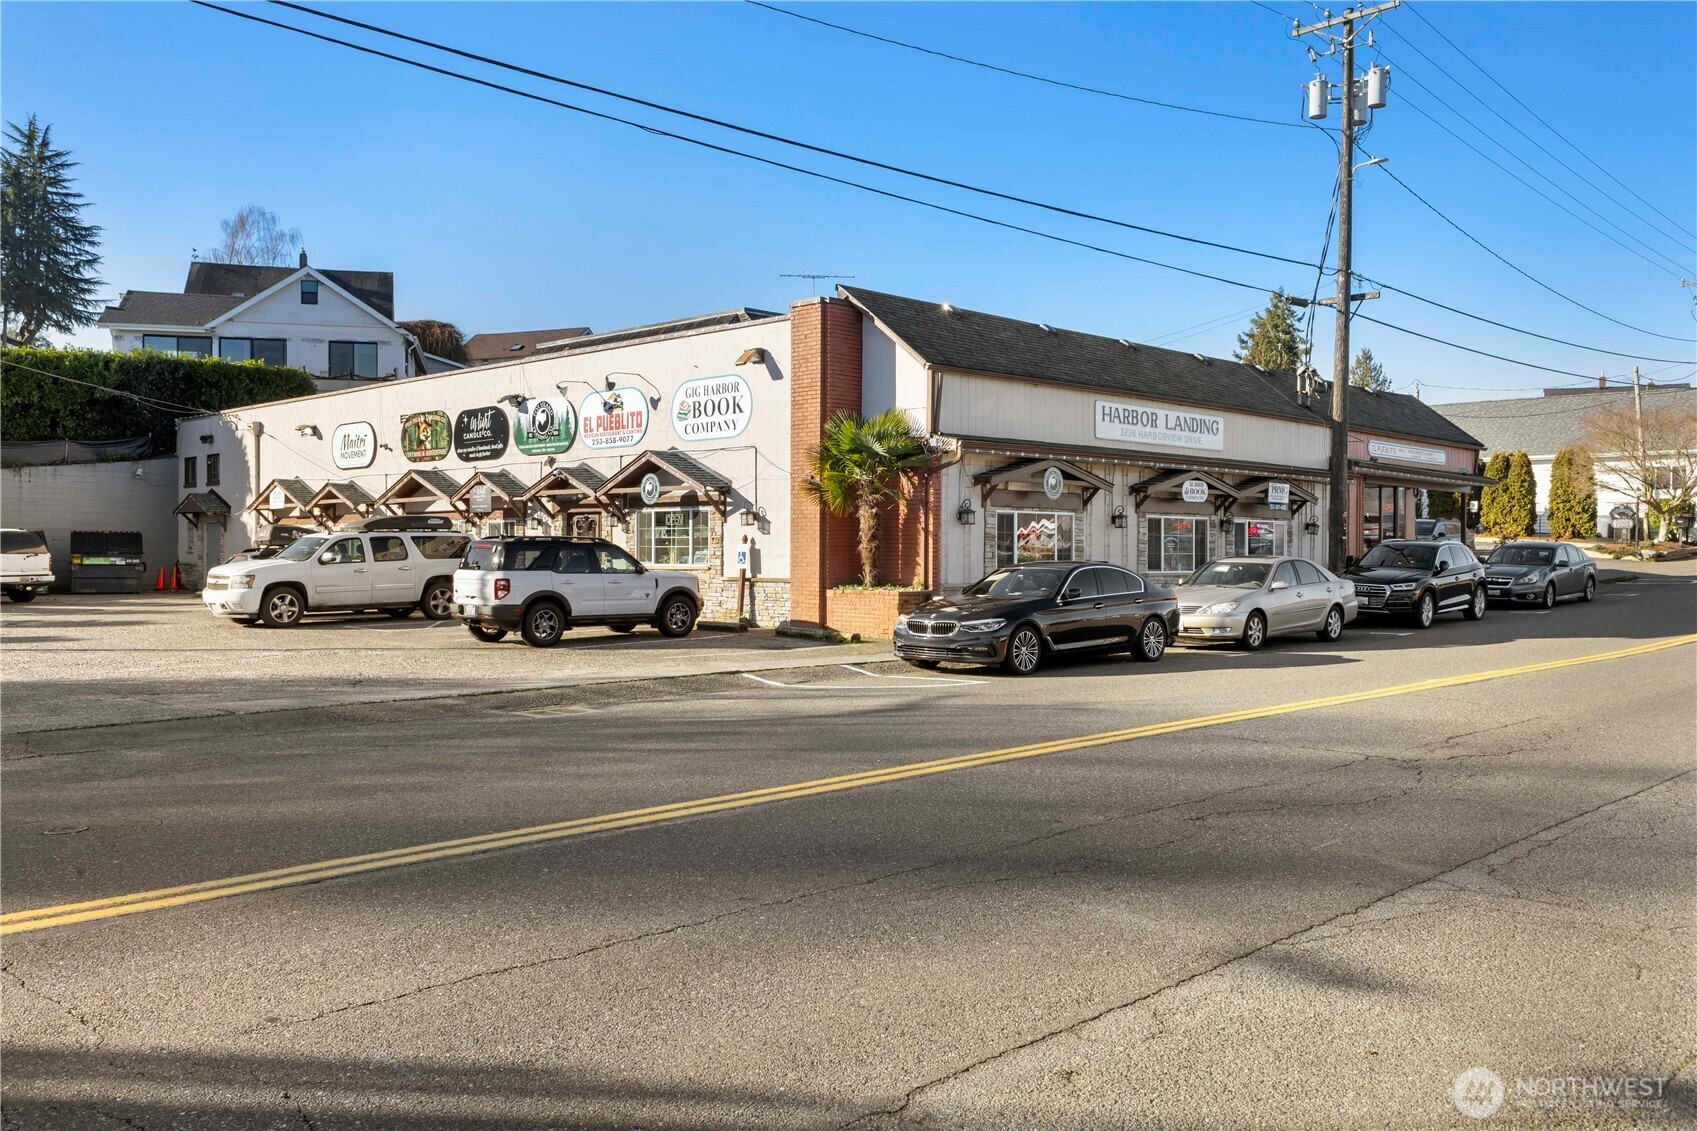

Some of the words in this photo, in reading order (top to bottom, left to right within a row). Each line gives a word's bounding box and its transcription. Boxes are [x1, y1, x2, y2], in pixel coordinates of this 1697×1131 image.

[685, 386, 701, 399] GIG
[703, 381, 740, 397] HARBOR
[692, 395, 744, 419] BOOK
[583, 416, 595, 433] EL
[596, 410, 643, 432] PUEBLITO
[684, 418, 739, 435] COMPANY
[1102, 405, 1159, 428] HARBOR
[1165, 413, 1220, 436] LANDING
[463, 431, 483, 440] CANDLE
[592, 435, 635, 446] 253-858-9077
[1120, 428, 1137, 438] 3226
[1139, 431, 1183, 443] HARBORVIEW
[1184, 436, 1202, 445] DRIVE
[340, 450, 367, 460] MOVEMENT
[1271, 485, 1288, 496] PRMG
